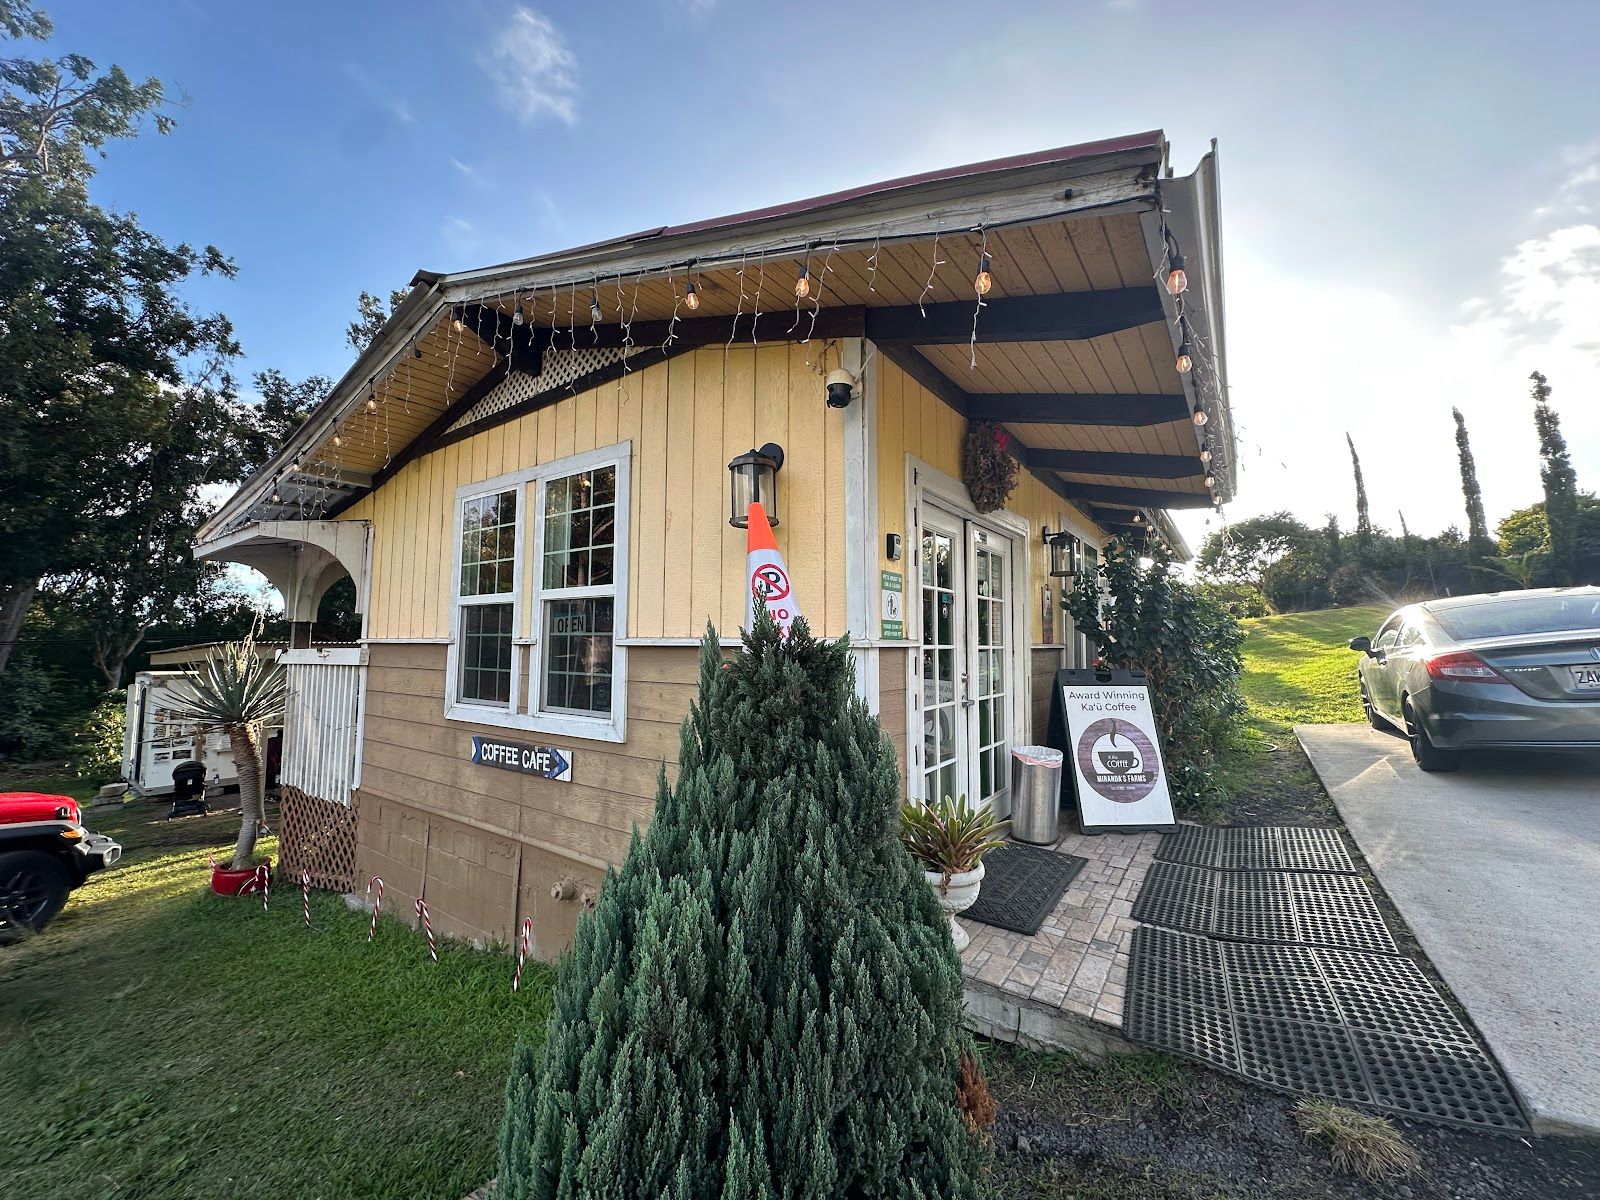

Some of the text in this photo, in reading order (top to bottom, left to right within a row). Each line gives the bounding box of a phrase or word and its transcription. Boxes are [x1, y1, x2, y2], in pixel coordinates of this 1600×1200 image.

[1068, 690, 1145, 701] Award Winning
[1105, 702, 1137, 711] Coffee
[481, 743, 519, 766] COFFEE
[1096, 773, 1147, 783] MIRANDA'S FARMS
